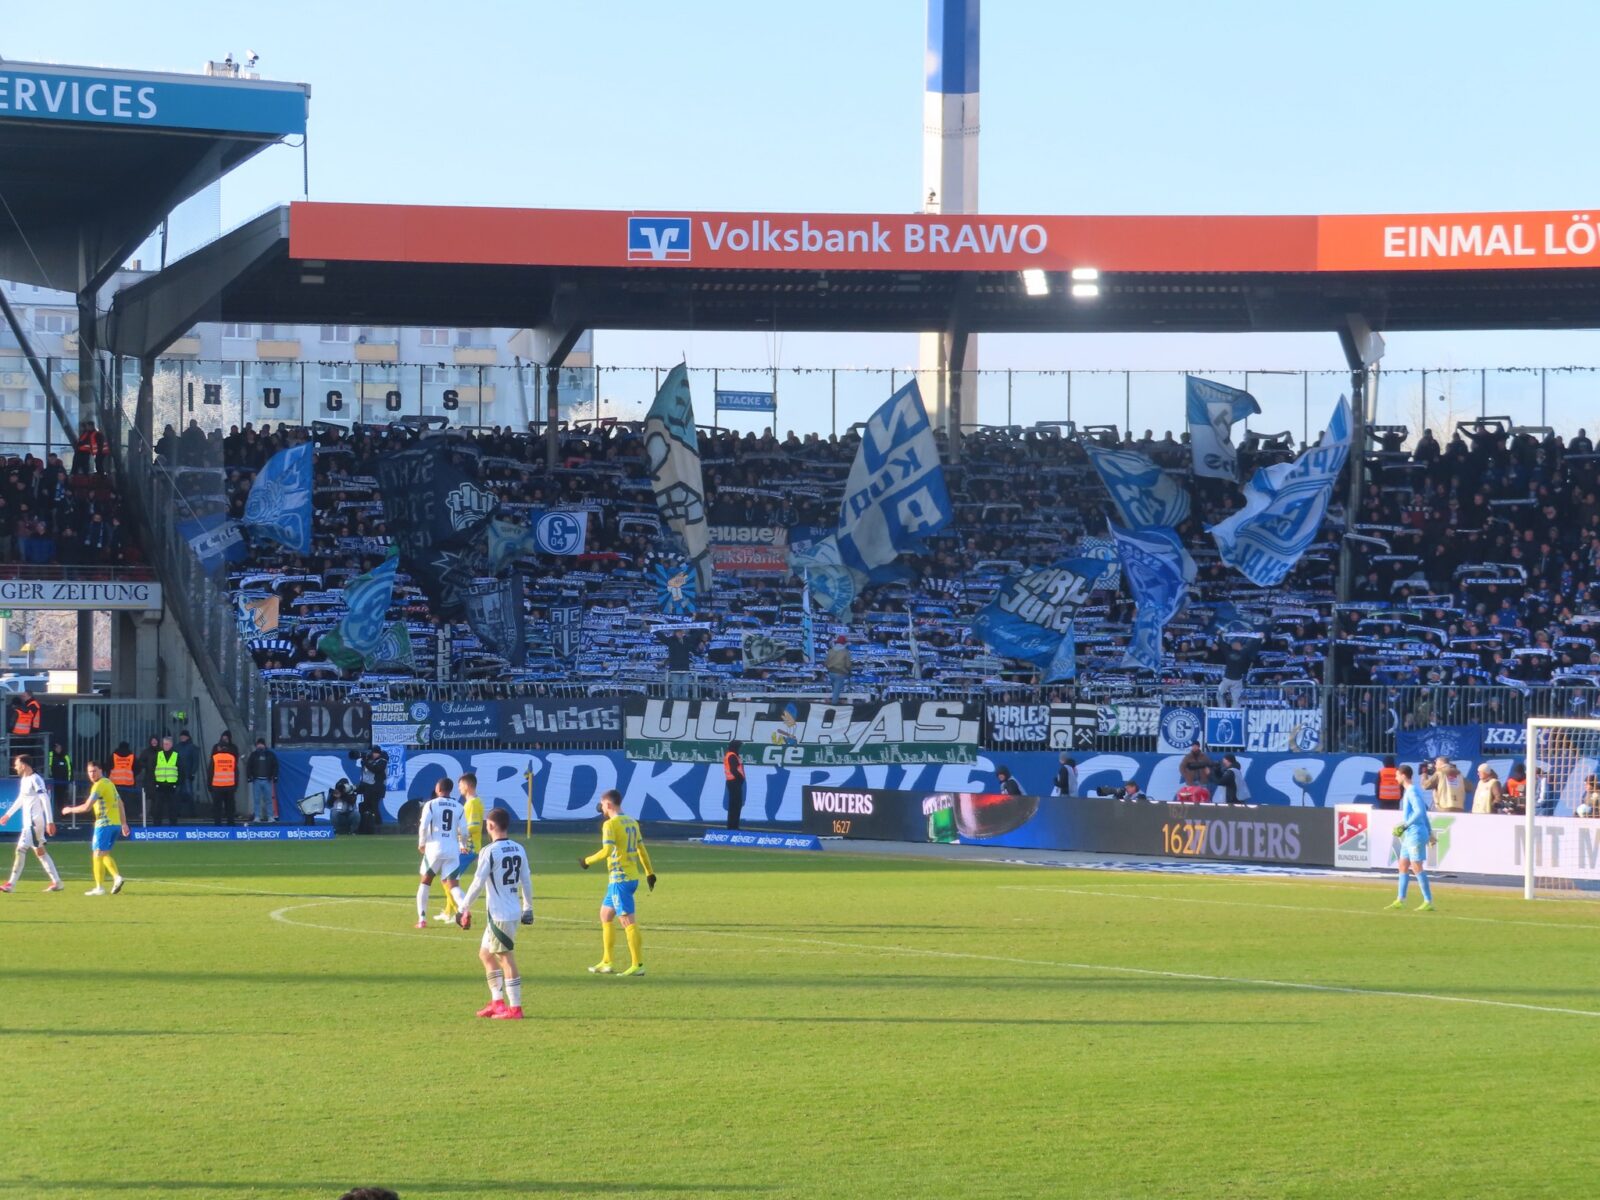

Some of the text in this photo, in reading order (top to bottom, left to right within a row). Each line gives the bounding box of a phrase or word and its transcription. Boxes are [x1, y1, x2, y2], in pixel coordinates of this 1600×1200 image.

[703, 220, 1048, 254] Volksbank BRAWO
[1383, 214, 1600, 257] EINMAL LÖ
[716, 395, 761, 406] ATTACKE
[0, 582, 149, 601] GER ZEITUNG
[509, 703, 621, 734] HUGOS
[640, 698, 967, 752] ULTRAS
[986, 705, 1050, 726] MARLER
[1118, 706, 1160, 721] BLUE
[1247, 709, 1323, 732] SUPPORTERS
[1246, 732, 1290, 752] CLUB
[811, 791, 873, 814] WOLTERS
[442, 809, 453, 831] 9
[832, 820, 851, 834] 1627
[1162, 823, 1207, 854] 1627
[1184, 819, 1301, 860] WOLTERS
[1357, 833, 1367, 850] 2
[502, 855, 521, 885] 23
